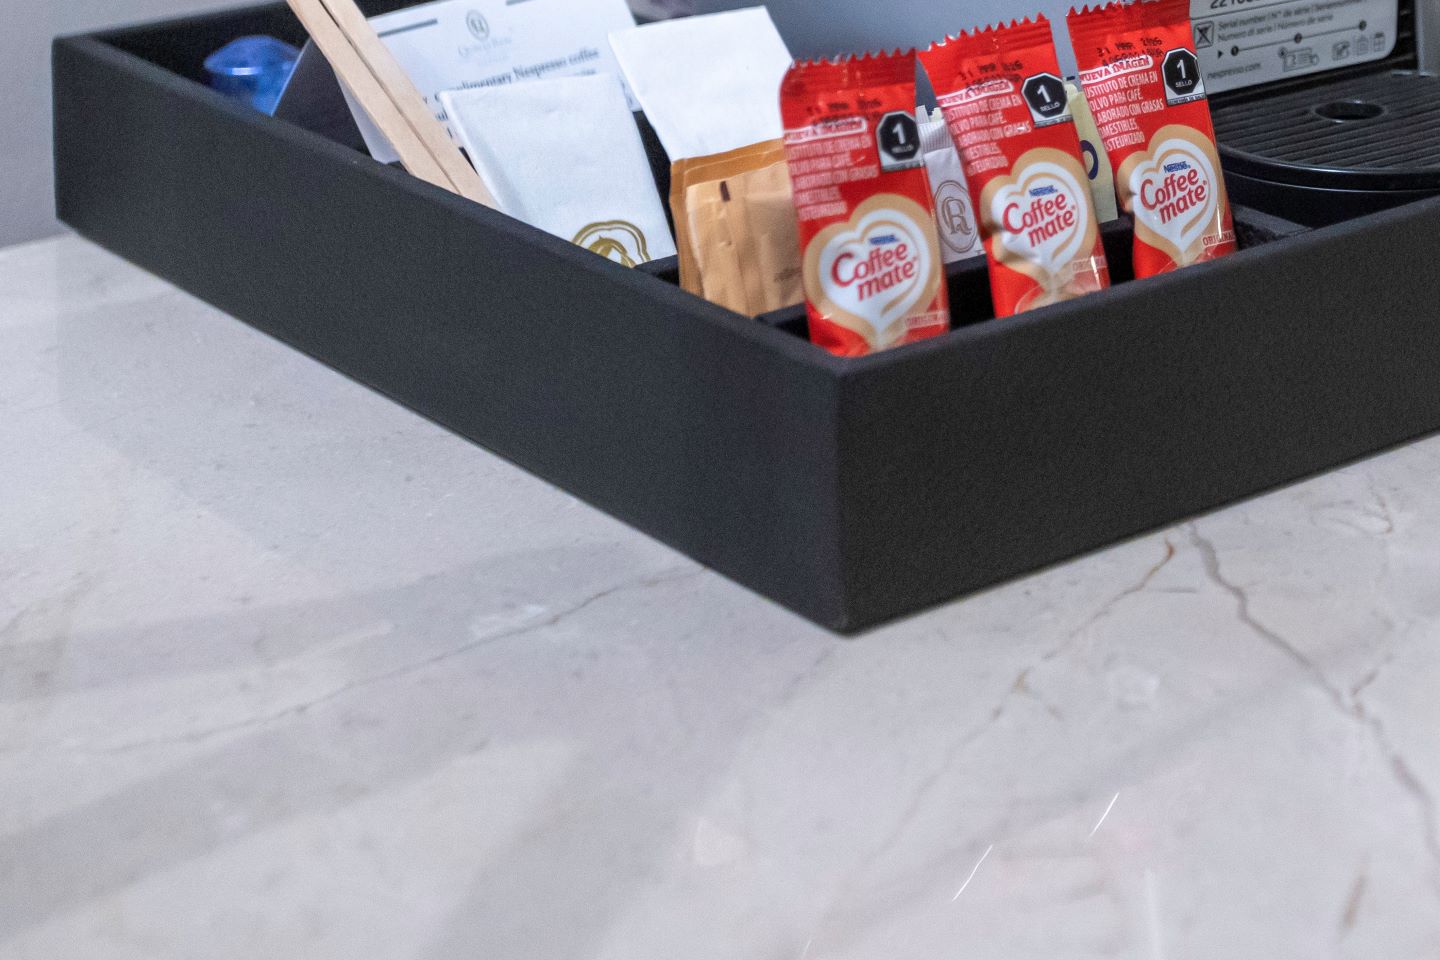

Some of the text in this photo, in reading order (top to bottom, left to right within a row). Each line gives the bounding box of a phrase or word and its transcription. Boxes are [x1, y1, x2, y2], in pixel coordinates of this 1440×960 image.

[1149, 70, 1158, 83] EN
[1175, 79, 1193, 88] SELLO
[1176, 59, 1186, 79] 1
[1037, 83, 1051, 104] 1
[1140, 98, 1165, 114] GRASAS
[893, 122, 905, 145] 1
[1141, 169, 1199, 211] Coffee
[1159, 184, 1207, 224] mate
[1003, 194, 1067, 235] Coffee
[1028, 210, 1075, 248] mate
[831, 243, 907, 287] Coffee
[857, 261, 914, 302] mate
